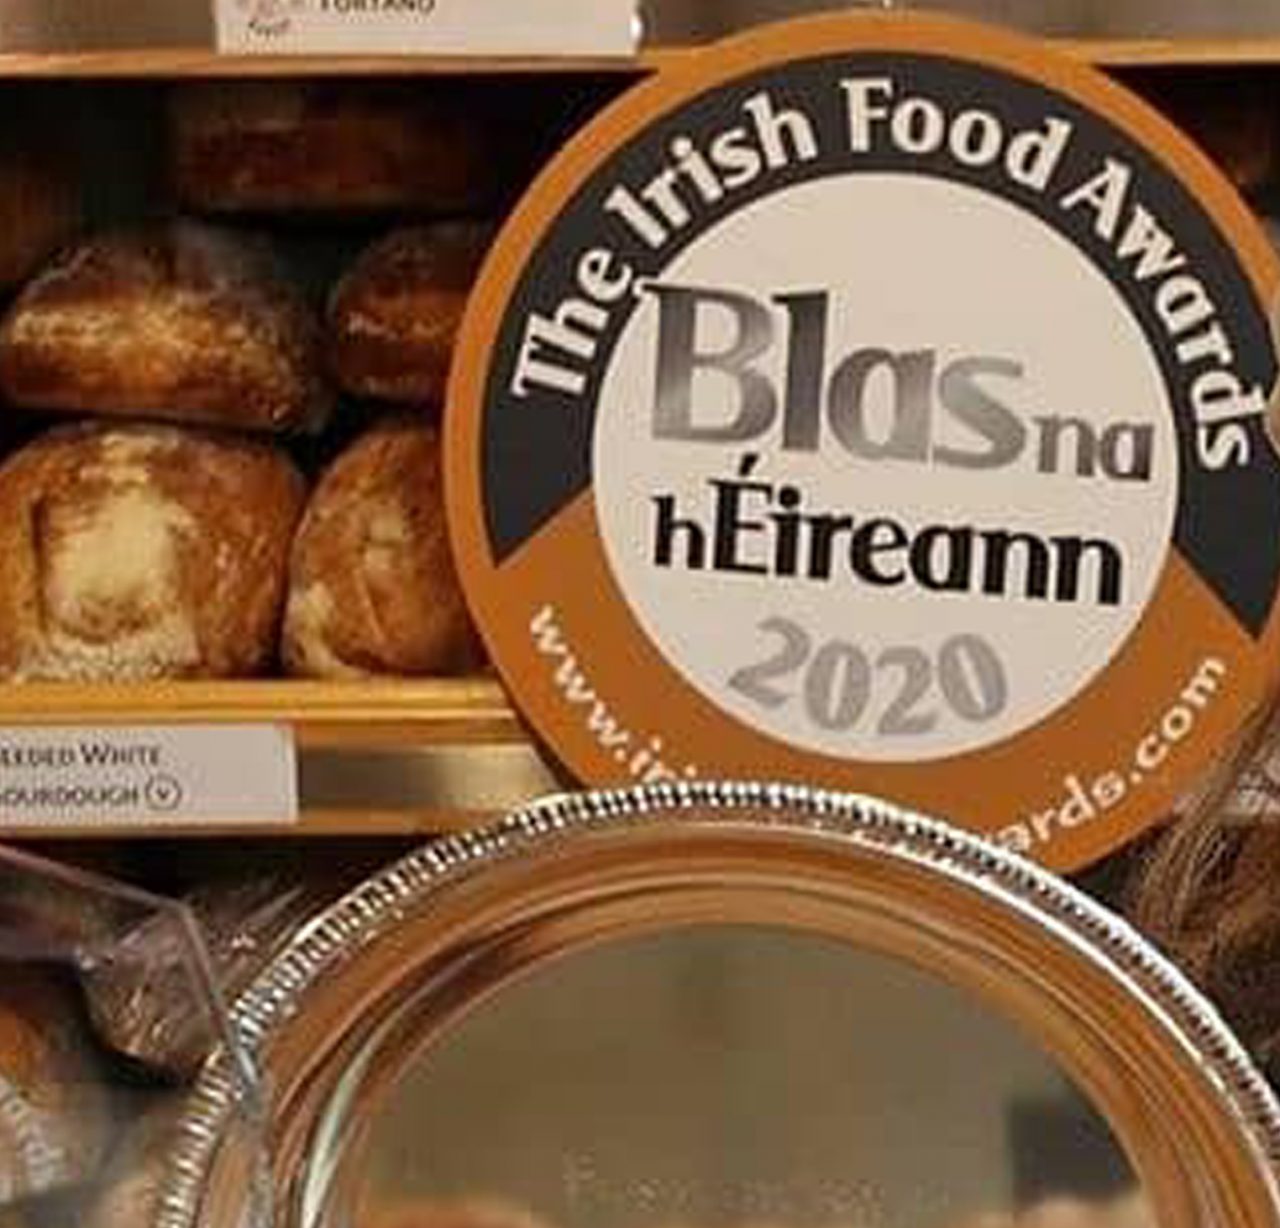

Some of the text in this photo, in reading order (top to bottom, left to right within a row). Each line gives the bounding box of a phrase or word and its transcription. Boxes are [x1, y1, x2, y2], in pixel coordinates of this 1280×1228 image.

[511, 76, 1265, 473] The Irish Food Awards
[640, 281, 1157, 483] Blas na
[651, 454, 1124, 606] hÉireann
[727, 615, 1011, 737] 2020
[0, 784, 139, 807] OURDOUGH
